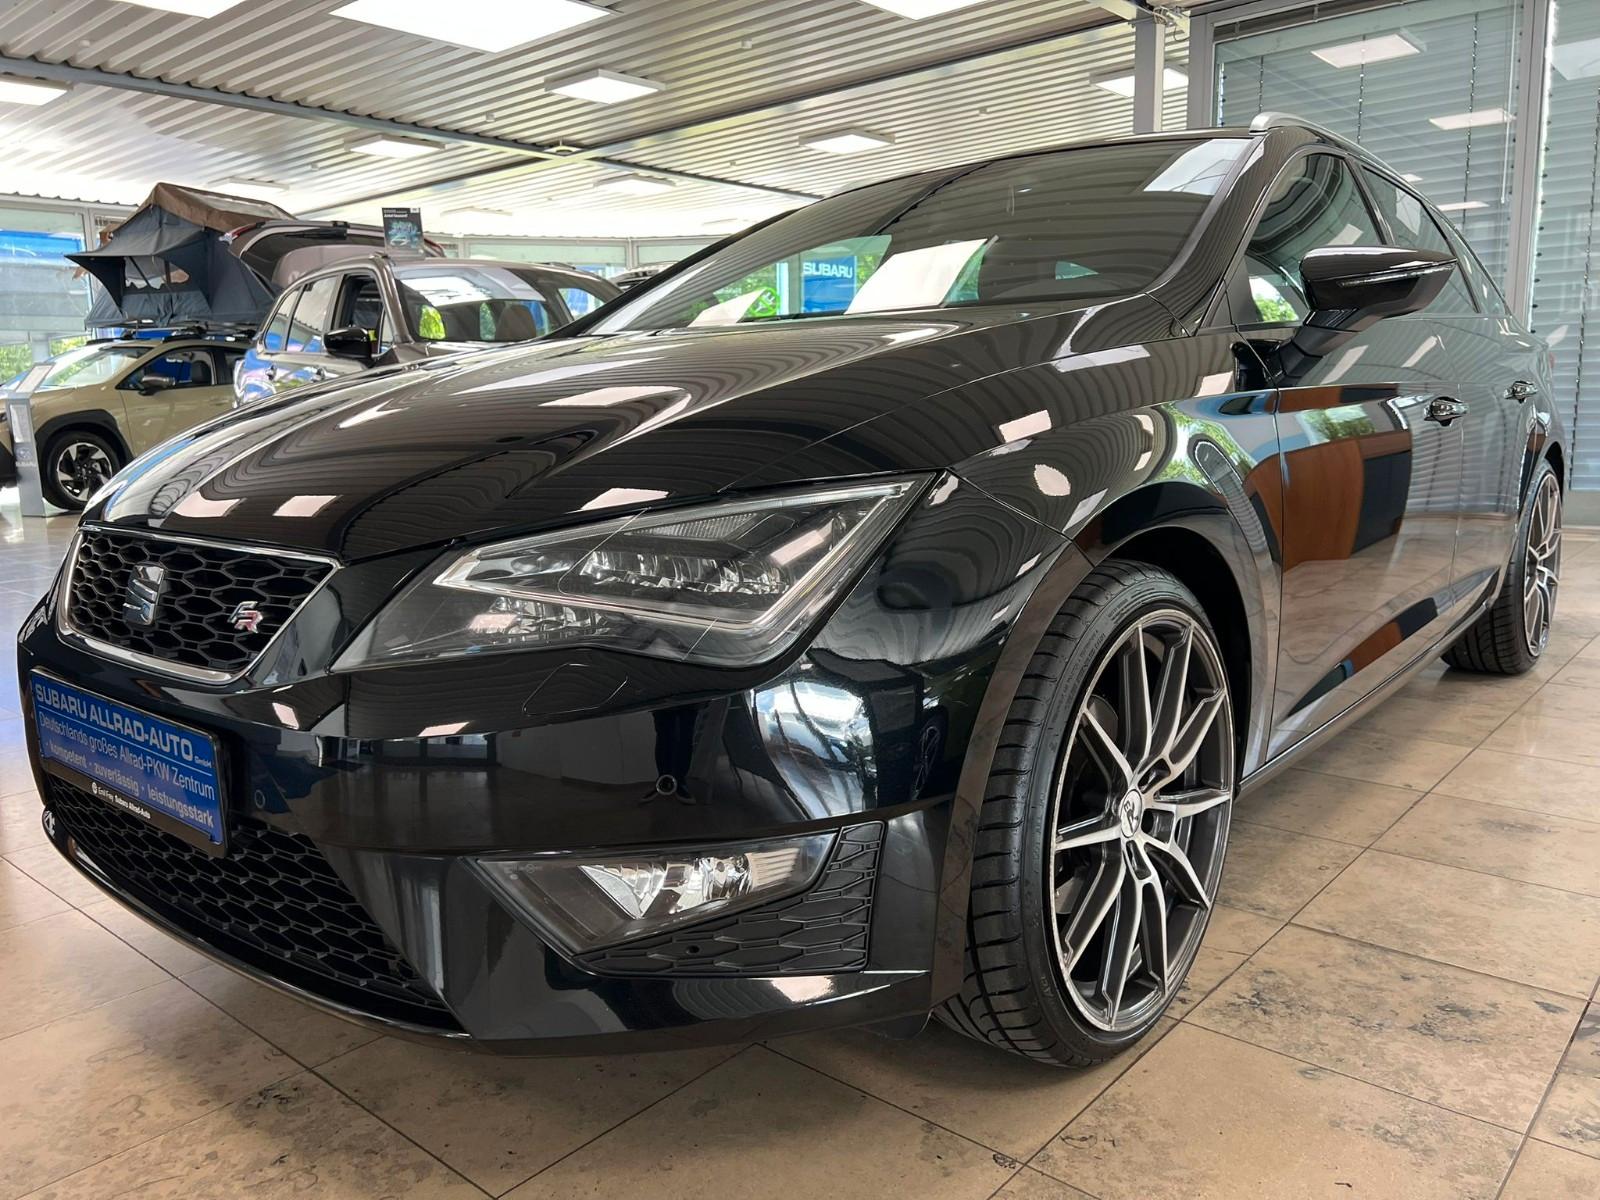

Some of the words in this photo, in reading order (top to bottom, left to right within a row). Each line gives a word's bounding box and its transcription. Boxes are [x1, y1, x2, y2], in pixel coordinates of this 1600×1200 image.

[803, 262, 853, 279] SUBARU
[34, 683, 87, 720] SUBARU
[90, 704, 194, 762] ALLRAD-AUTO
[39, 710, 88, 746] Deutschlands
[89, 736, 118, 760] großes
[120, 744, 170, 782] Allrad-PKW
[171, 766, 215, 801] Zentrum
[147, 783, 215, 829] leistungsstark
